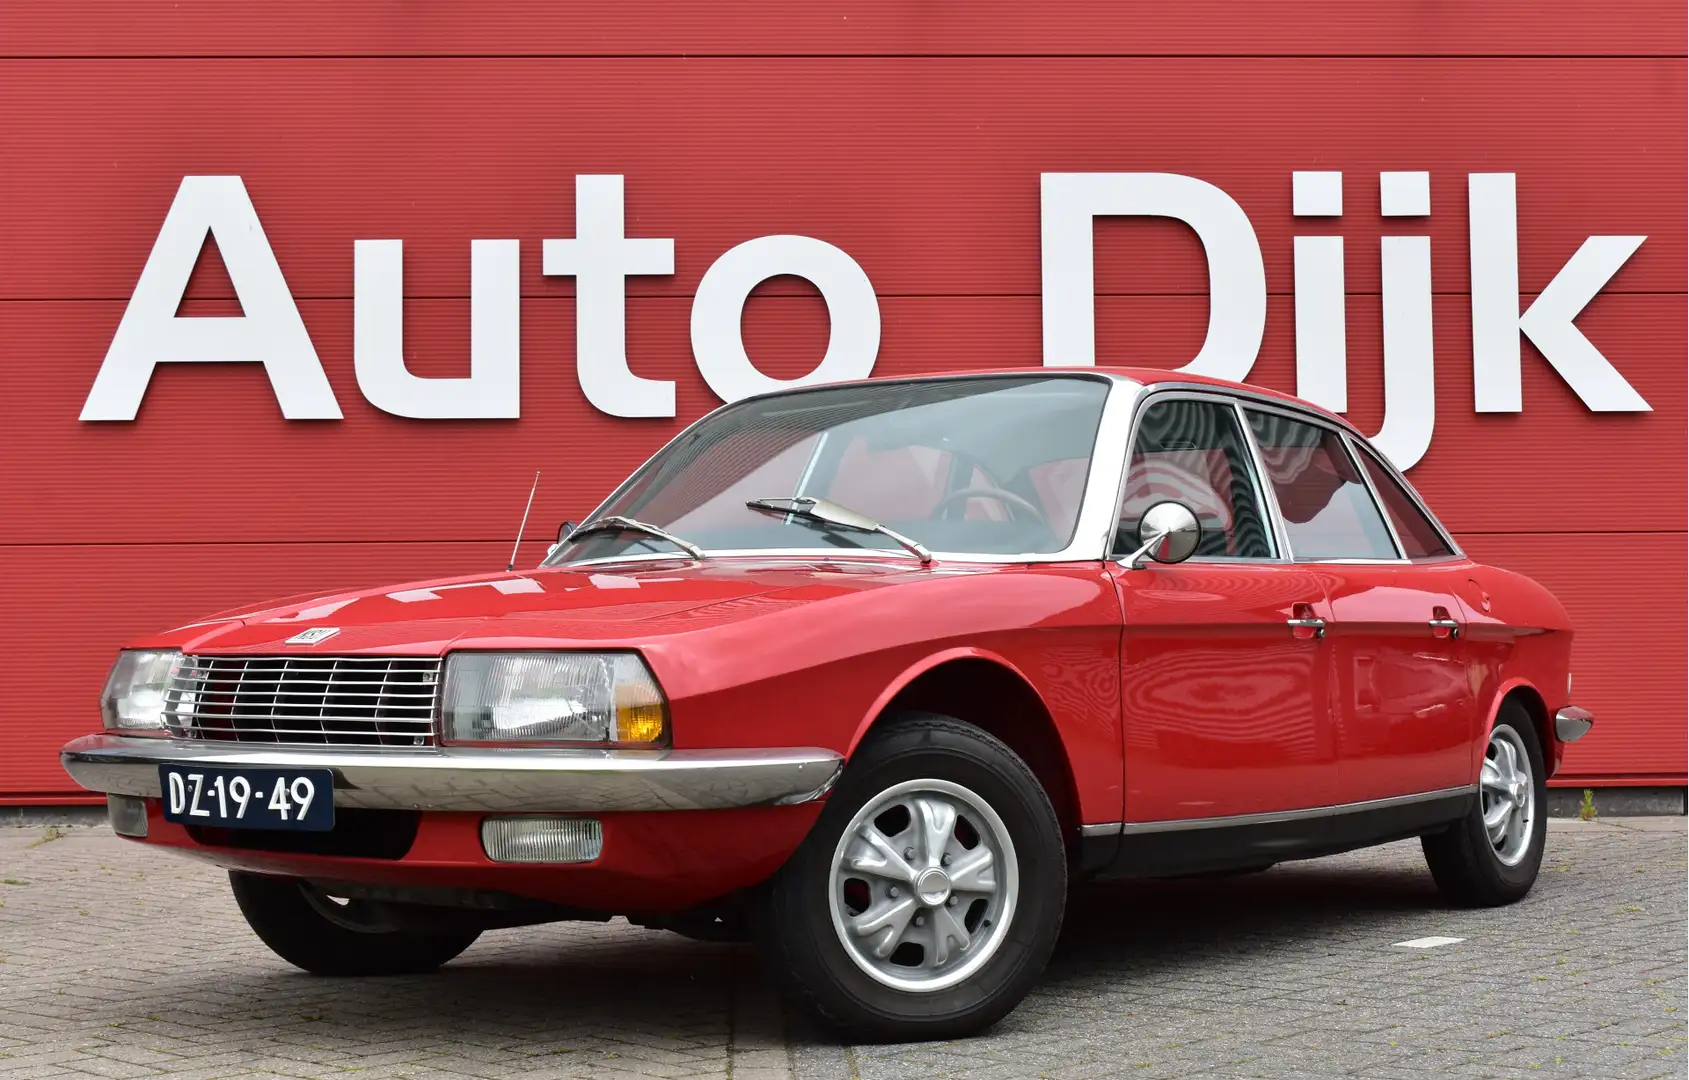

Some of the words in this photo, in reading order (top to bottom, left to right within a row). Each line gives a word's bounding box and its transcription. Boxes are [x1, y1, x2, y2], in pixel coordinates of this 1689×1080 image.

[79, 174, 881, 420] Auto
[1041, 171, 1654, 473] Dijk
[168, 772, 315, 821] DZ-19-49
